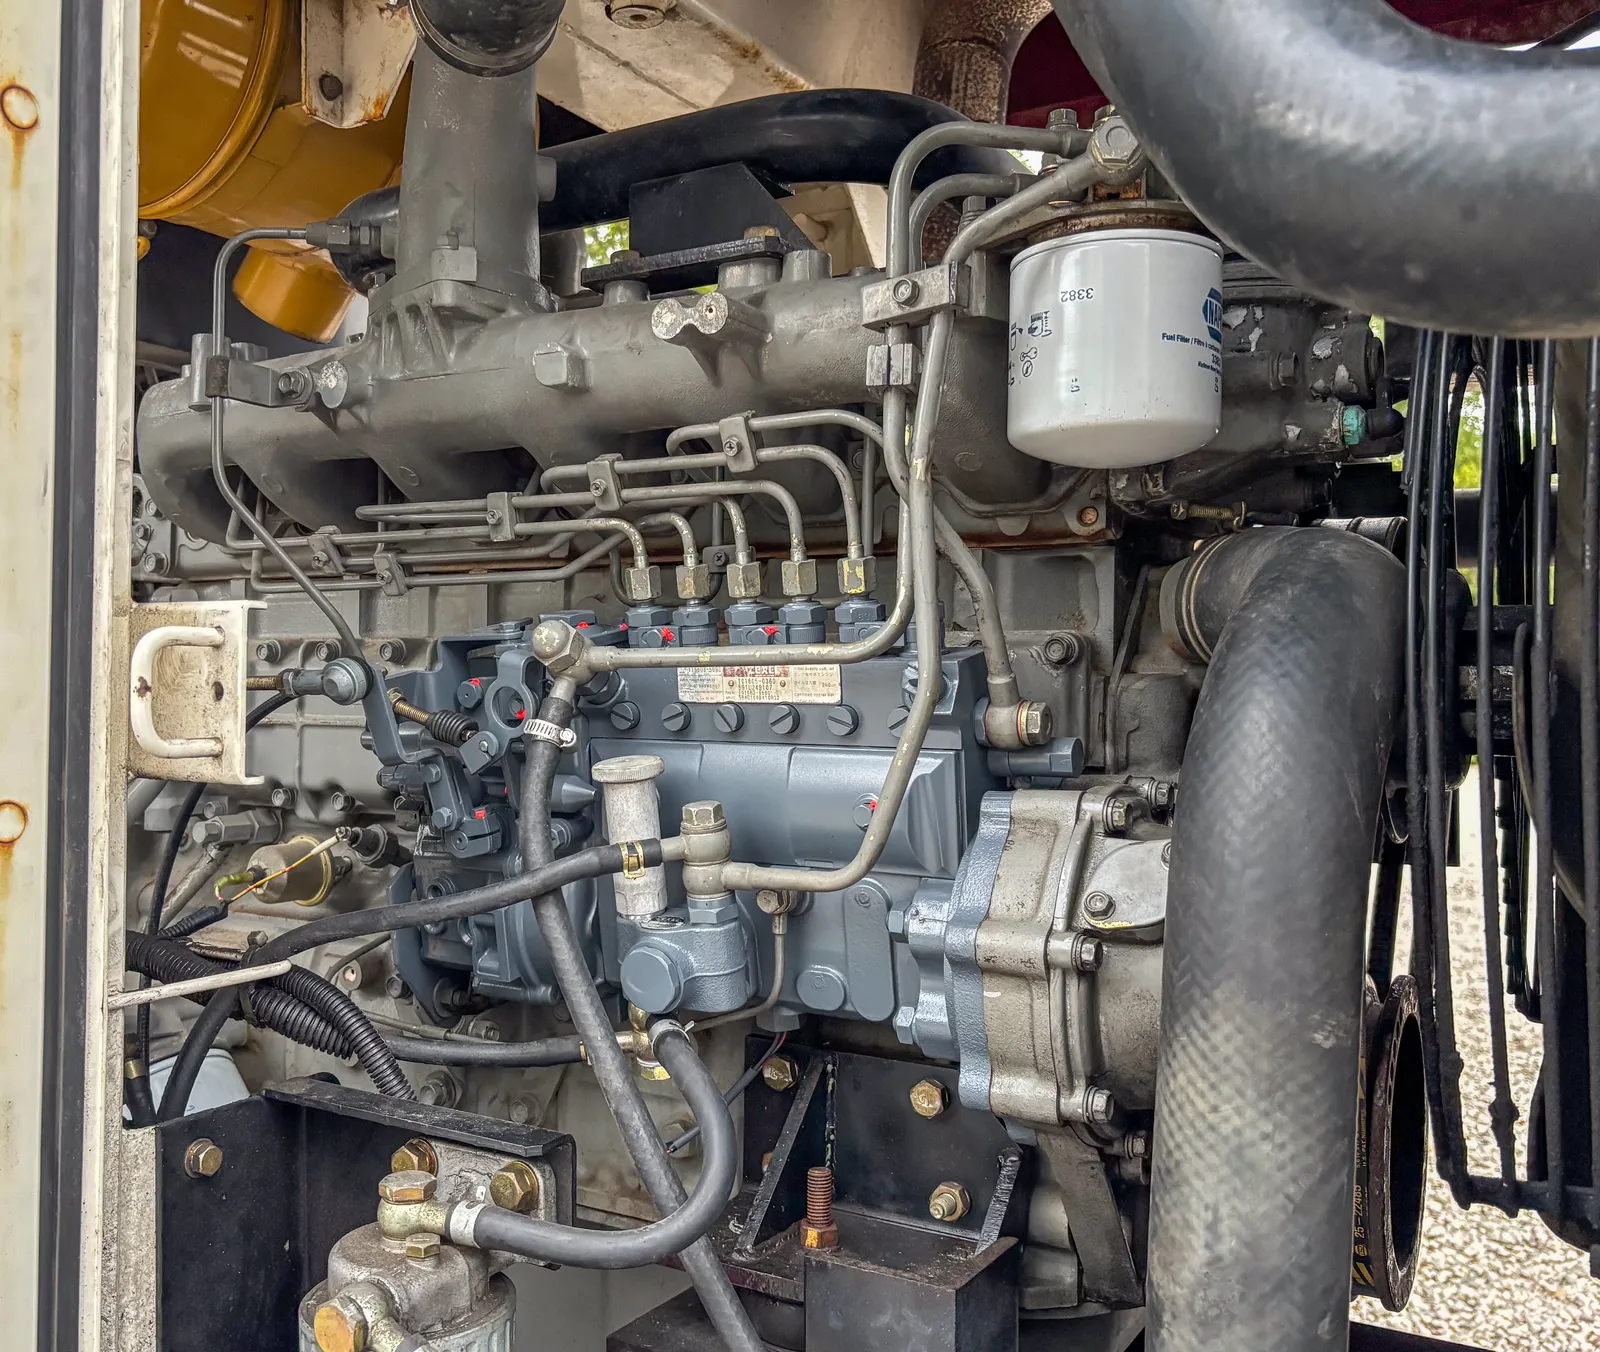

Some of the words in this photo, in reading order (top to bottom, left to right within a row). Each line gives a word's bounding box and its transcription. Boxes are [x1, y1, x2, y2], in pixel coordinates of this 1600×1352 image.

[1060, 286, 1094, 303] 3382
[1162, 332, 1176, 341] Fuel
[1176, 335, 1191, 344] Filter
